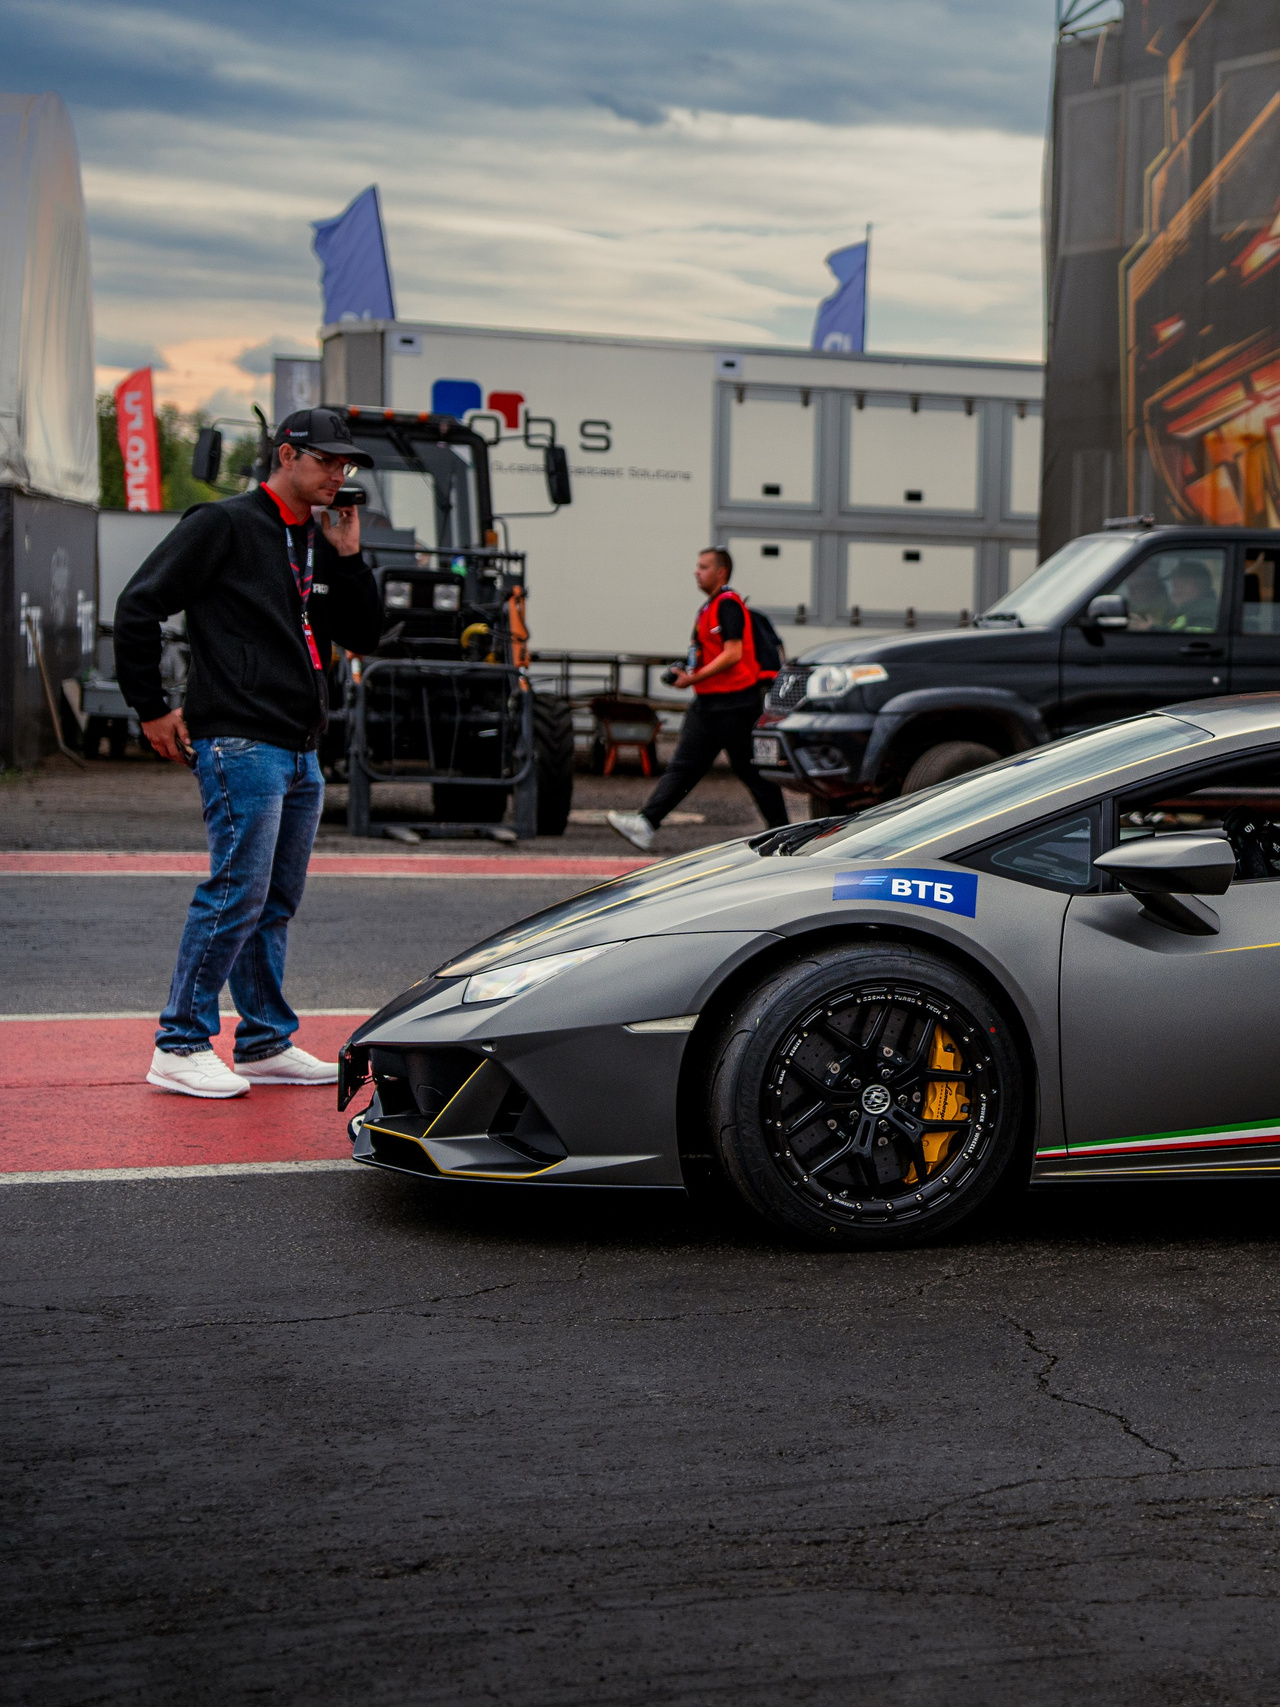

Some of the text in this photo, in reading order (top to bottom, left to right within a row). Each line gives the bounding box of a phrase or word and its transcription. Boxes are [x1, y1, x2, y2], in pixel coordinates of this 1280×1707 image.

[891, 878, 954, 904] ВТБ
[925, 1003, 942, 1016] TECH
[940, 1083, 953, 1120] Lamborg
[967, 1103, 987, 1154] POWER WHEELS
